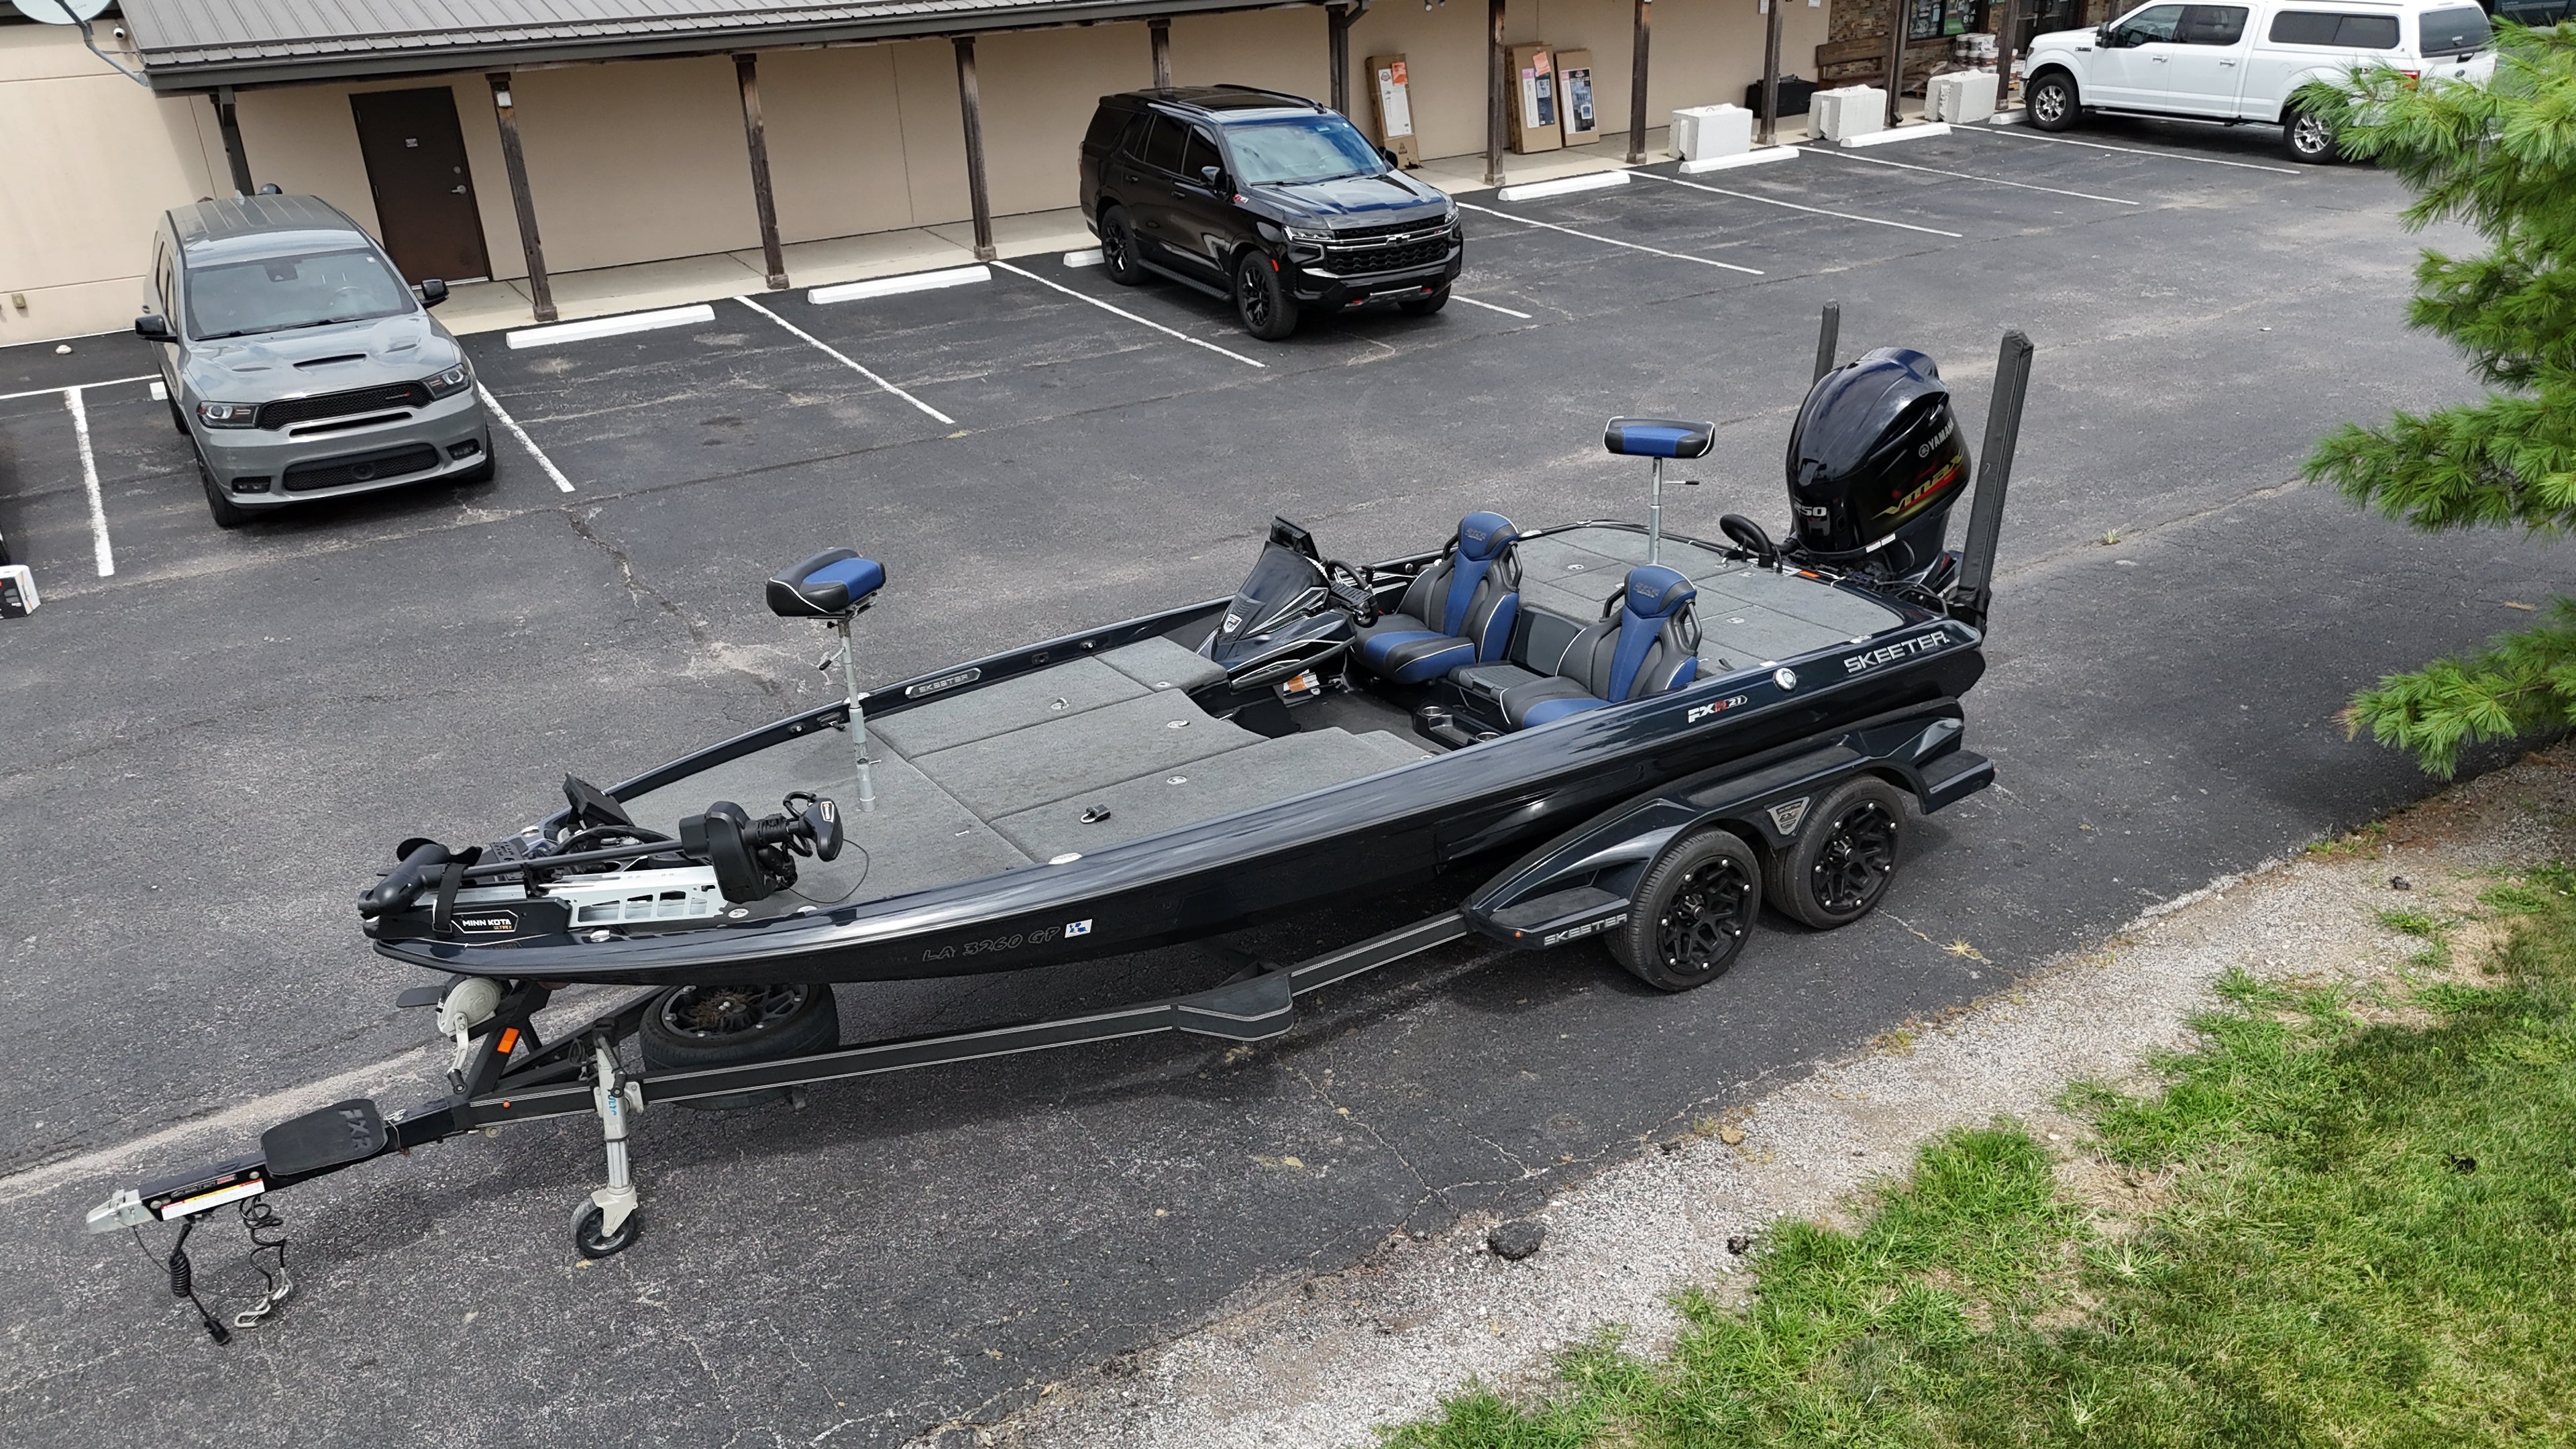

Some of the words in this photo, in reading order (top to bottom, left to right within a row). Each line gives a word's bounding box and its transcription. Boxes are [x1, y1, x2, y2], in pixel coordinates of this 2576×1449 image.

[1843, 631, 1947, 673] SKEETER
[918, 674, 969, 693] SKEETER
[922, 946, 956, 961] LA
[1028, 926, 1061, 944] GP
[1544, 913, 1627, 946] SKEETER
[337, 1108, 373, 1152] FXR
